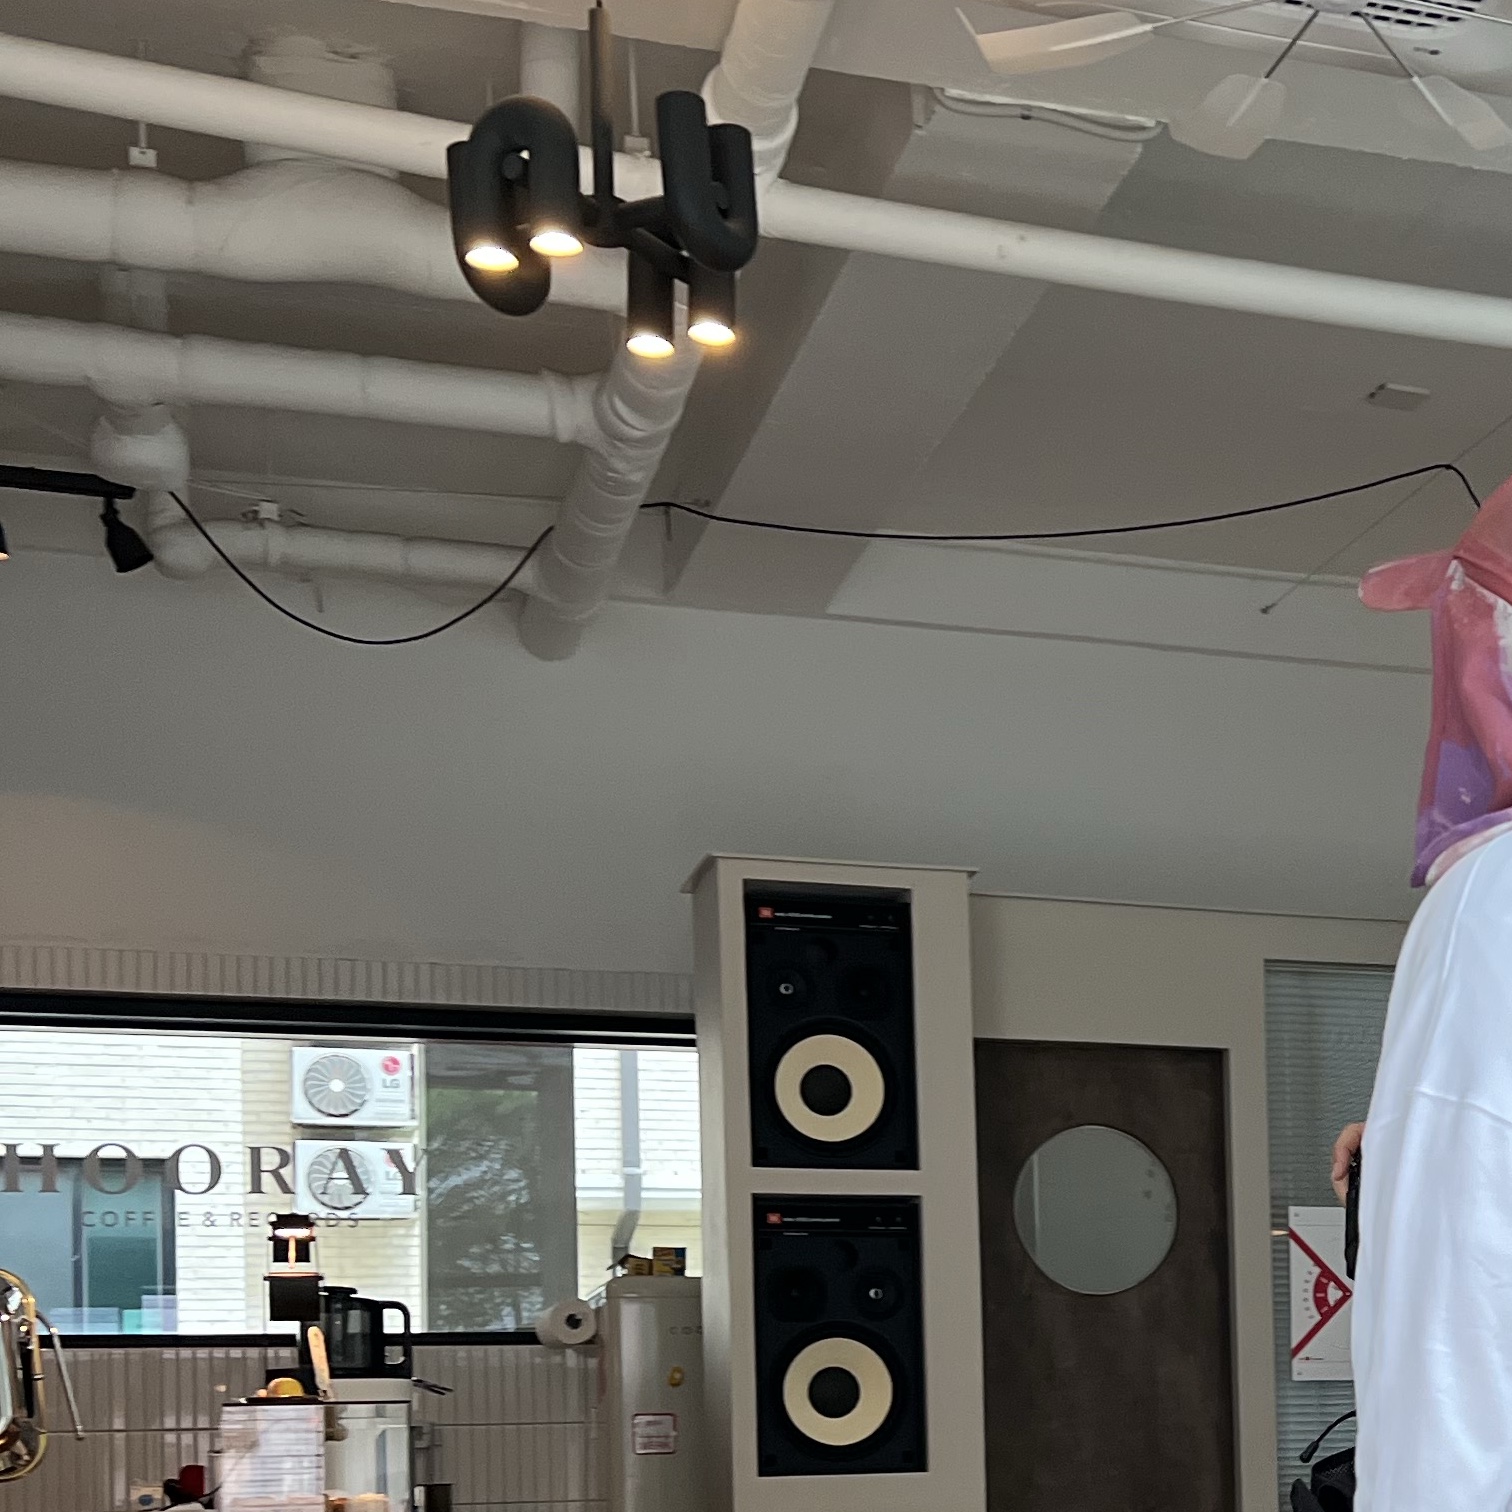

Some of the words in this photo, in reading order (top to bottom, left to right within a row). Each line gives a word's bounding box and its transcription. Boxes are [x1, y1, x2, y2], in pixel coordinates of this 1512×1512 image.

[381, 1078, 401, 1089] LG
[1, 1143, 427, 1195] HOORAY
[82, 1210, 190, 1228] COFFE
[201, 1211, 216, 1228] &
[229, 1211, 359, 1229] RECRDS
